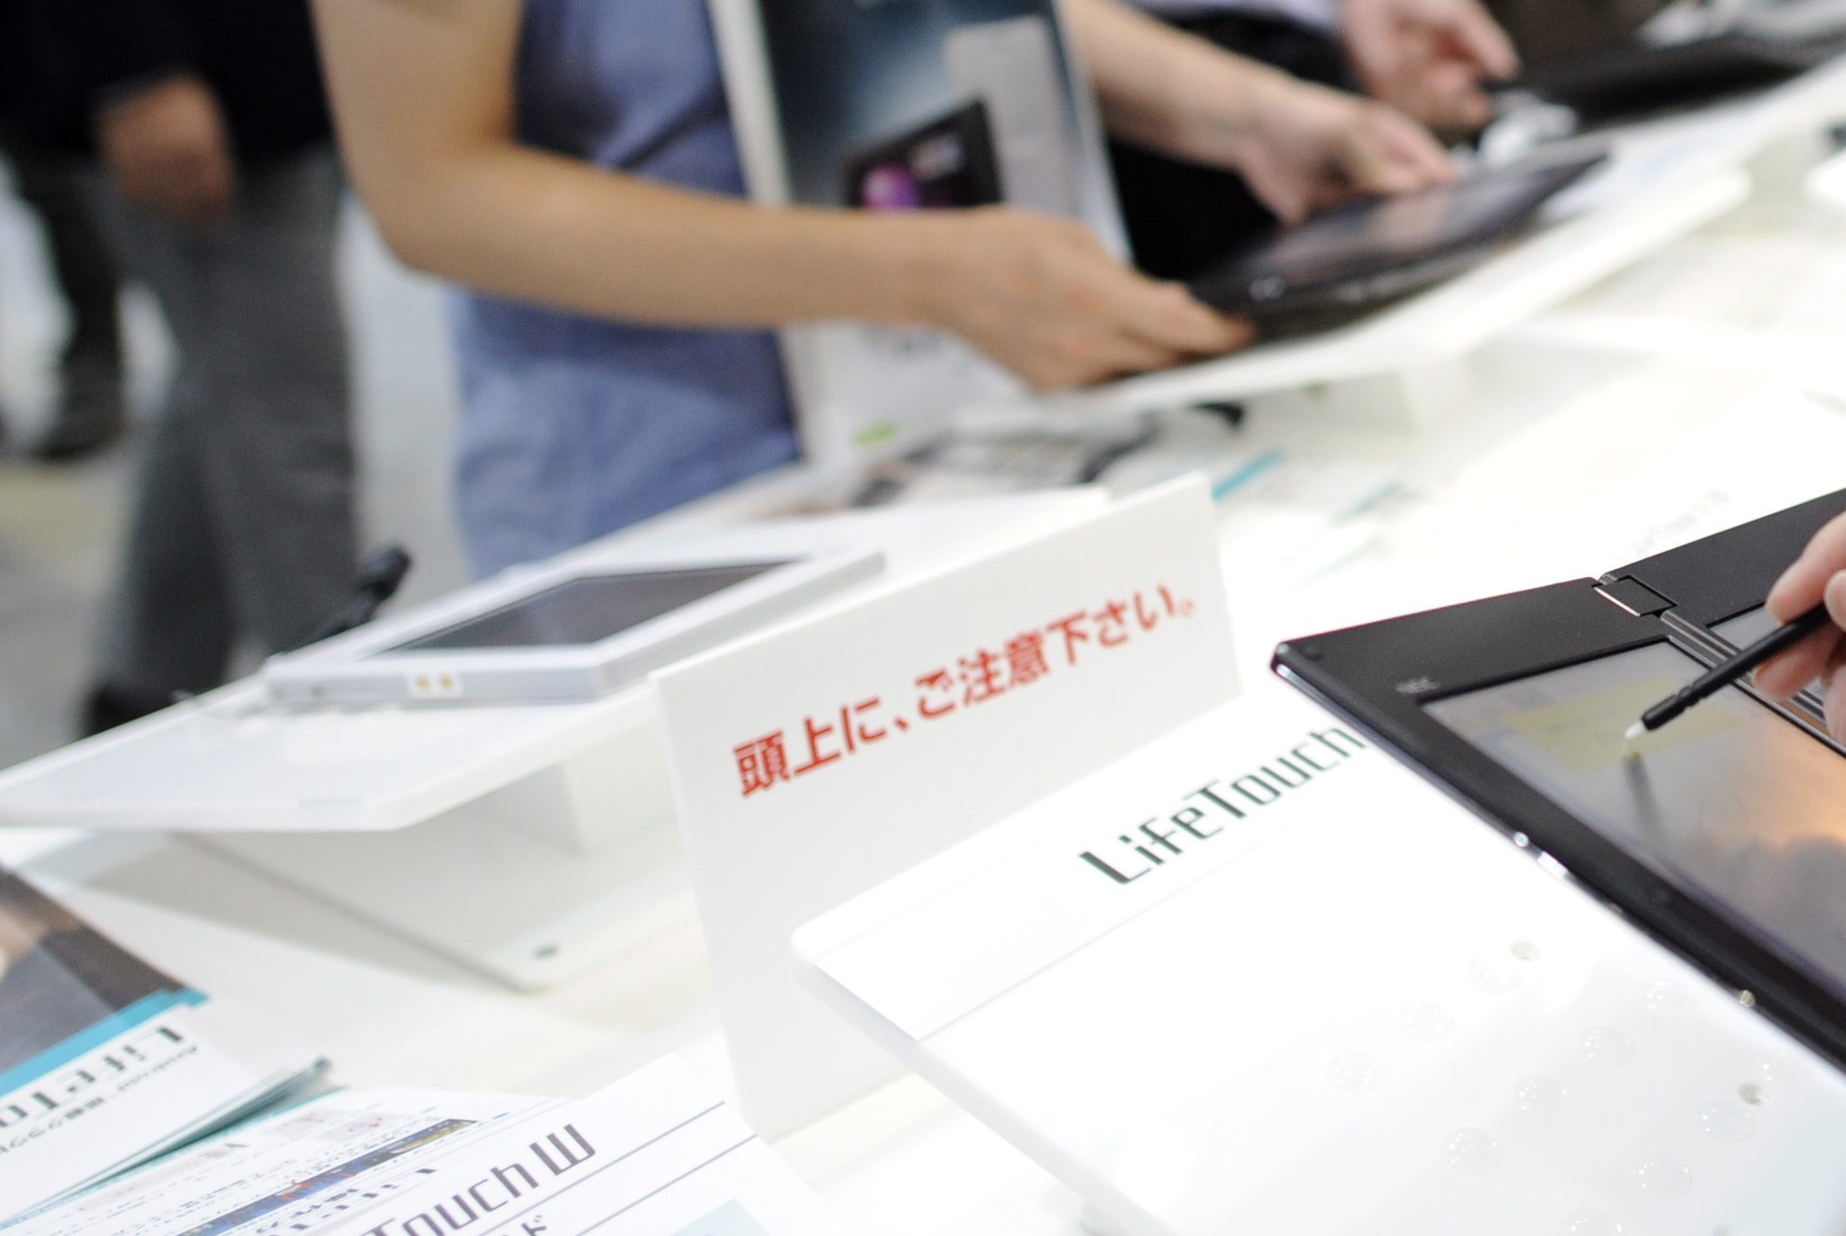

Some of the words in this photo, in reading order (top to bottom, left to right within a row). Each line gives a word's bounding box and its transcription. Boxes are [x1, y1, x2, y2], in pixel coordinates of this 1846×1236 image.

[734, 584, 1196, 798] 頭上に、ご注意下さい。
[1079, 727, 1366, 884] LifeTouch
